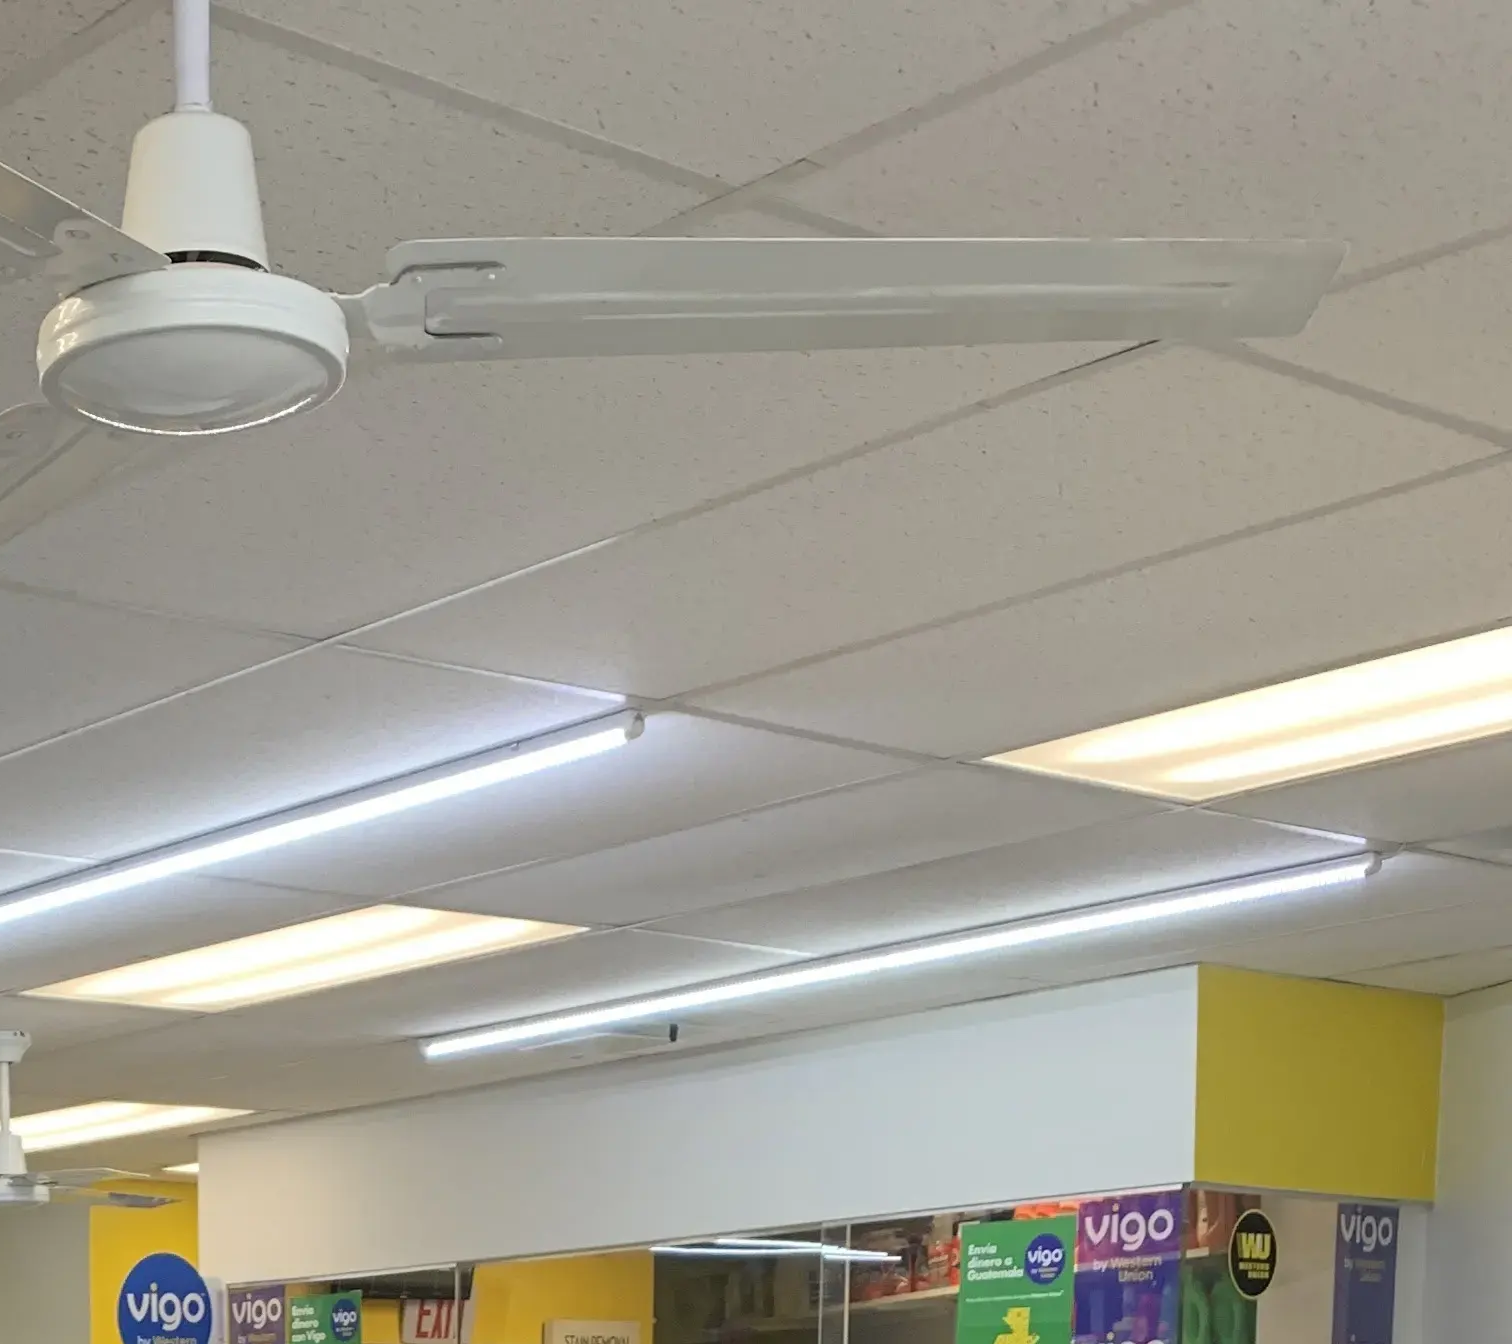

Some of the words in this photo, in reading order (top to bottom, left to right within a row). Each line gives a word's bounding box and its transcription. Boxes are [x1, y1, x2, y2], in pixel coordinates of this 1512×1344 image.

[1085, 1203, 1174, 1251] vigo
[1341, 1205, 1393, 1252] vigo
[968, 1256, 1003, 1269] dinero
[1028, 1246, 1063, 1266] vigo
[1093, 1260, 1107, 1272] by
[1108, 1256, 1162, 1269] Western
[968, 1266, 1024, 1281] Guatemala
[1119, 1270, 1153, 1282] Union
[126, 1282, 206, 1331] vigo
[232, 1293, 282, 1329] vigo
[332, 1309, 357, 1326] vigo
